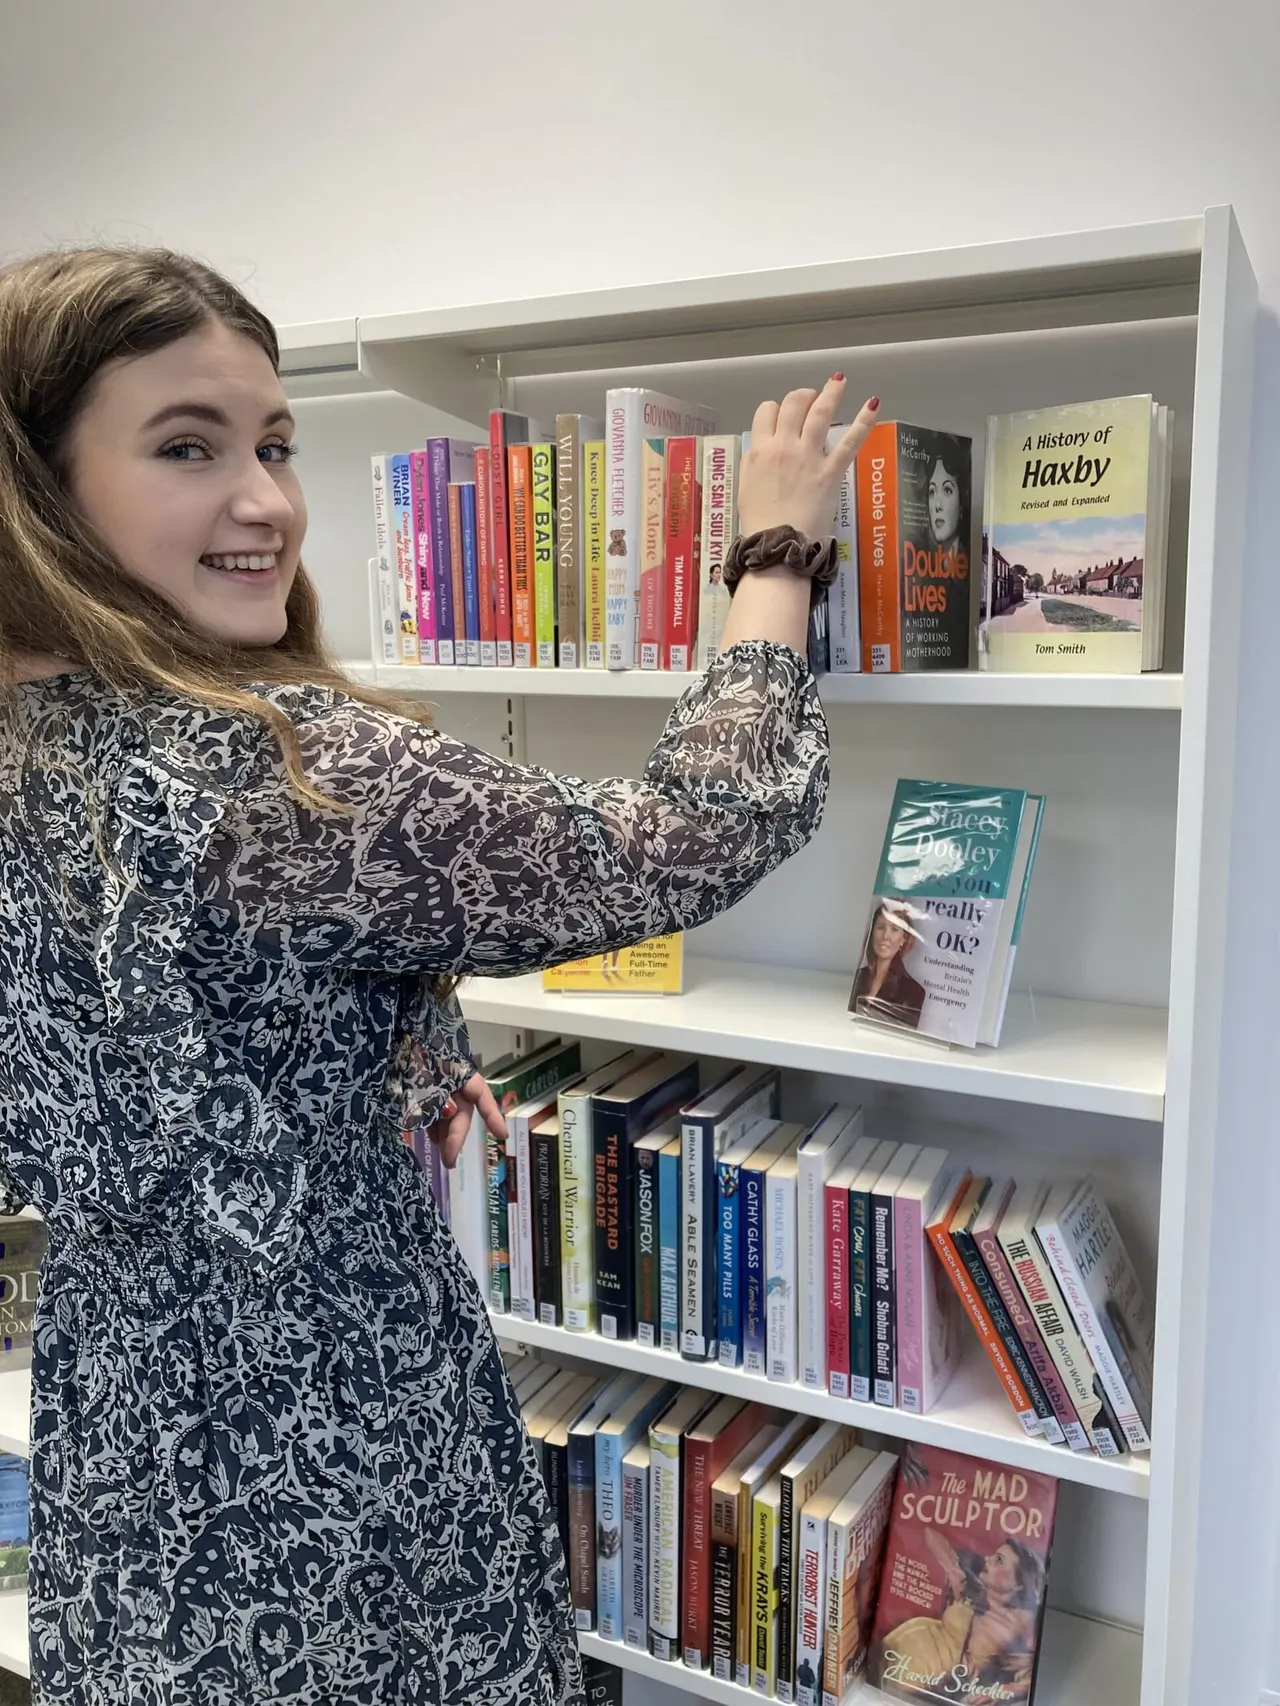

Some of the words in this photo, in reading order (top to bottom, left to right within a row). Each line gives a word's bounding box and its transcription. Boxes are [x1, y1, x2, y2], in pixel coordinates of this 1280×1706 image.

[612, 408, 625, 464] GIOVANNA
[900, 432, 919, 447] Helen
[1022, 436, 1032, 451] A
[1036, 432, 1090, 448] History
[1093, 425, 1113, 444] of
[559, 434, 572, 490] WILL
[590, 452, 598, 485] Knee
[711, 447, 725, 481] AUNG
[900, 447, 931, 464] McCarthy
[1022, 454, 1112, 489] Haxby
[393, 466, 401, 506] VINER
[401, 464, 410, 506] BRIAN
[414, 458, 424, 492] Dylan
[514, 487, 524, 497] WE
[534, 451, 550, 502] GAY
[647, 466, 661, 508] Liv's
[871, 457, 885, 521] Double
[374, 487, 384, 519] Fallen
[514, 498, 525, 513] CAN
[589, 488, 599, 519] Deep
[611, 468, 625, 517] FLETCHER
[711, 484, 725, 509] SAN
[1020, 499, 1050, 510] Revised
[1052, 498, 1068, 508] and
[1071, 494, 1110, 506] Expanded
[416, 495, 425, 532] Jones
[514, 513, 525, 525] DO
[591, 522, 600, 534] in
[710, 512, 724, 540] SUU
[377, 523, 386, 549] Idols
[514, 526, 527, 553] BETTER
[535, 512, 550, 563] BAR
[560, 495, 573, 567] YOUNG
[646, 510, 660, 560] Alone
[873, 526, 887, 567] Lives
[418, 532, 428, 568] Shiny
[515, 554, 528, 574] THAN
[591, 539, 600, 563] Life
[674, 555, 684, 573] TIM
[709, 541, 723, 561] KYI
[903, 540, 968, 579] Double
[420, 567, 430, 590] and
[516, 575, 528, 591] THIS
[904, 576, 946, 613] Lives
[421, 591, 431, 620] New
[673, 577, 684, 628] MARSHALL
[905, 634, 914, 643] OF
[916, 633, 949, 643] WORKING
[912, 618, 940, 629] HISTORY
[905, 647, 951, 658] MOTHERHOOD
[1035, 644, 1054, 654] Tom
[1056, 643, 1086, 654] Smith
[928, 804, 1009, 840] Stacey
[915, 832, 1002, 871] Dooley
[951, 876, 993, 894] you
[924, 899, 987, 928] really
[629, 951, 670, 959] Awesome
[936, 930, 980, 955] OK?
[629, 970, 656, 978] Father
[923, 956, 975, 975] Understanding
[923, 979, 946, 991] Mental
[946, 985, 970, 997] Health
[928, 992, 967, 1010] Emergency
[525, 1067, 560, 1099] CARLOS
[562, 1108, 578, 1181] Chemical
[607, 1134, 618, 1168] THE
[688, 1129, 696, 1163] BRIAN
[538, 1142, 550, 1200] PRAETORIAN
[687, 1164, 696, 1205] LAVERY
[487, 1166, 500, 1215] MESSIAH
[595, 1154, 606, 1228] BRIGADE
[639, 1169, 652, 1222] JASON
[747, 1181, 759, 1225] CATHY
[564, 1185, 578, 1247] Warrior
[607, 1173, 619, 1250] BASTARD
[723, 1206, 733, 1230] TOO
[831, 1199, 845, 1232] Kate
[1071, 1198, 1101, 1243] MAGGIE
[491, 1219, 500, 1248] CARLOS
[640, 1223, 653, 1254] FOX
[687, 1213, 698, 1253] ABLE
[747, 1227, 759, 1269] GLASS
[875, 1207, 888, 1266] Remember
[1006, 1239, 1031, 1261] THE
[1075, 1218, 1114, 1280] HARTLEY
[660, 1246, 677, 1275] MAX
[723, 1233, 733, 1268] MANY
[599, 1271, 617, 1280] SAM
[686, 1257, 698, 1318] SEAMEN
[723, 1270, 733, 1299] PILLS
[830, 1238, 845, 1310] Garraway
[876, 1266, 889, 1291] Me?
[980, 1239, 1030, 1326] Consumed
[1015, 1258, 1049, 1303] RUSSIAN
[661, 1275, 678, 1325] ARTHUR
[876, 1300, 890, 1341] Shobna
[935, 1233, 946, 1245] NO
[942, 1244, 956, 1268] SUCH
[953, 1267, 968, 1293] THING
[965, 1291, 975, 1304] AS
[971, 1304, 990, 1337] NORMAL
[989, 1342, 1009, 1373] BRYONY
[1005, 1371, 1025, 1407] GORDON
[1034, 1302, 1065, 1337] AFFAIR
[1046, 1233, 1072, 1275] Behind
[1063, 1276, 1085, 1308] Closed
[1079, 1310, 1096, 1338] Doors
[1094, 1344, 1112, 1373] MAGGIE
[1108, 1374, 1126, 1406] HARTLEY
[876, 1341, 890, 1375] Gulati
[1055, 1338, 1074, 1368] DAVID
[1025, 1340, 1047, 1373] Arifa
[1042, 1377, 1069, 1417] Akbar
[1069, 1367, 1089, 1400] WALSH
[601, 1439, 610, 1452] my
[604, 1454, 613, 1476] hero
[624, 1473, 634, 1490] JIM
[694, 1455, 705, 1478] THE
[602, 1480, 614, 1521] THEO
[633, 1477, 643, 1511] MURDER
[694, 1480, 704, 1506] NEW
[780, 1480, 791, 1522] BLOOD
[940, 1472, 967, 1494] The
[972, 1470, 1028, 1502] MAD
[624, 1490, 634, 1522] FRASER
[653, 1493, 661, 1533] ELNOURY
[661, 1466, 674, 1550] AMERICAN
[900, 1493, 1044, 1538] SCULPTOR
[580, 1524, 588, 1538] On
[633, 1514, 643, 1545] UNDER
[693, 1508, 704, 1552] THREAT
[758, 1511, 768, 1553] Surviving
[780, 1522, 791, 1535] ON
[579, 1540, 589, 1568] Chapel
[633, 1546, 643, 1563] THE
[758, 1554, 767, 1570] the
[780, 1537, 791, 1560] THE
[581, 1569, 590, 1594] Sands
[653, 1558, 661, 1584] KEVIN
[688, 1559, 698, 1591] JASON
[780, 1562, 790, 1604] TRACKS
[804, 1549, 819, 1608] TERRORIST
[633, 1563, 644, 1619] MICROSCOPE
[652, 1586, 660, 1622] MAURER
[660, 1558, 673, 1626] RADICAL
[713, 1561, 731, 1616] TERROR
[756, 1571, 768, 1623] KRAYS
[828, 1577, 839, 1634] JEFFREY
[687, 1594, 698, 1632] BURKE
[803, 1607, 818, 1650] HUNTER
[826, 1633, 838, 1689] DAHMER
[883, 1649, 946, 1687] Harold
[943, 1663, 1015, 1701] Schechter
[590, 1686, 607, 1700] TO
